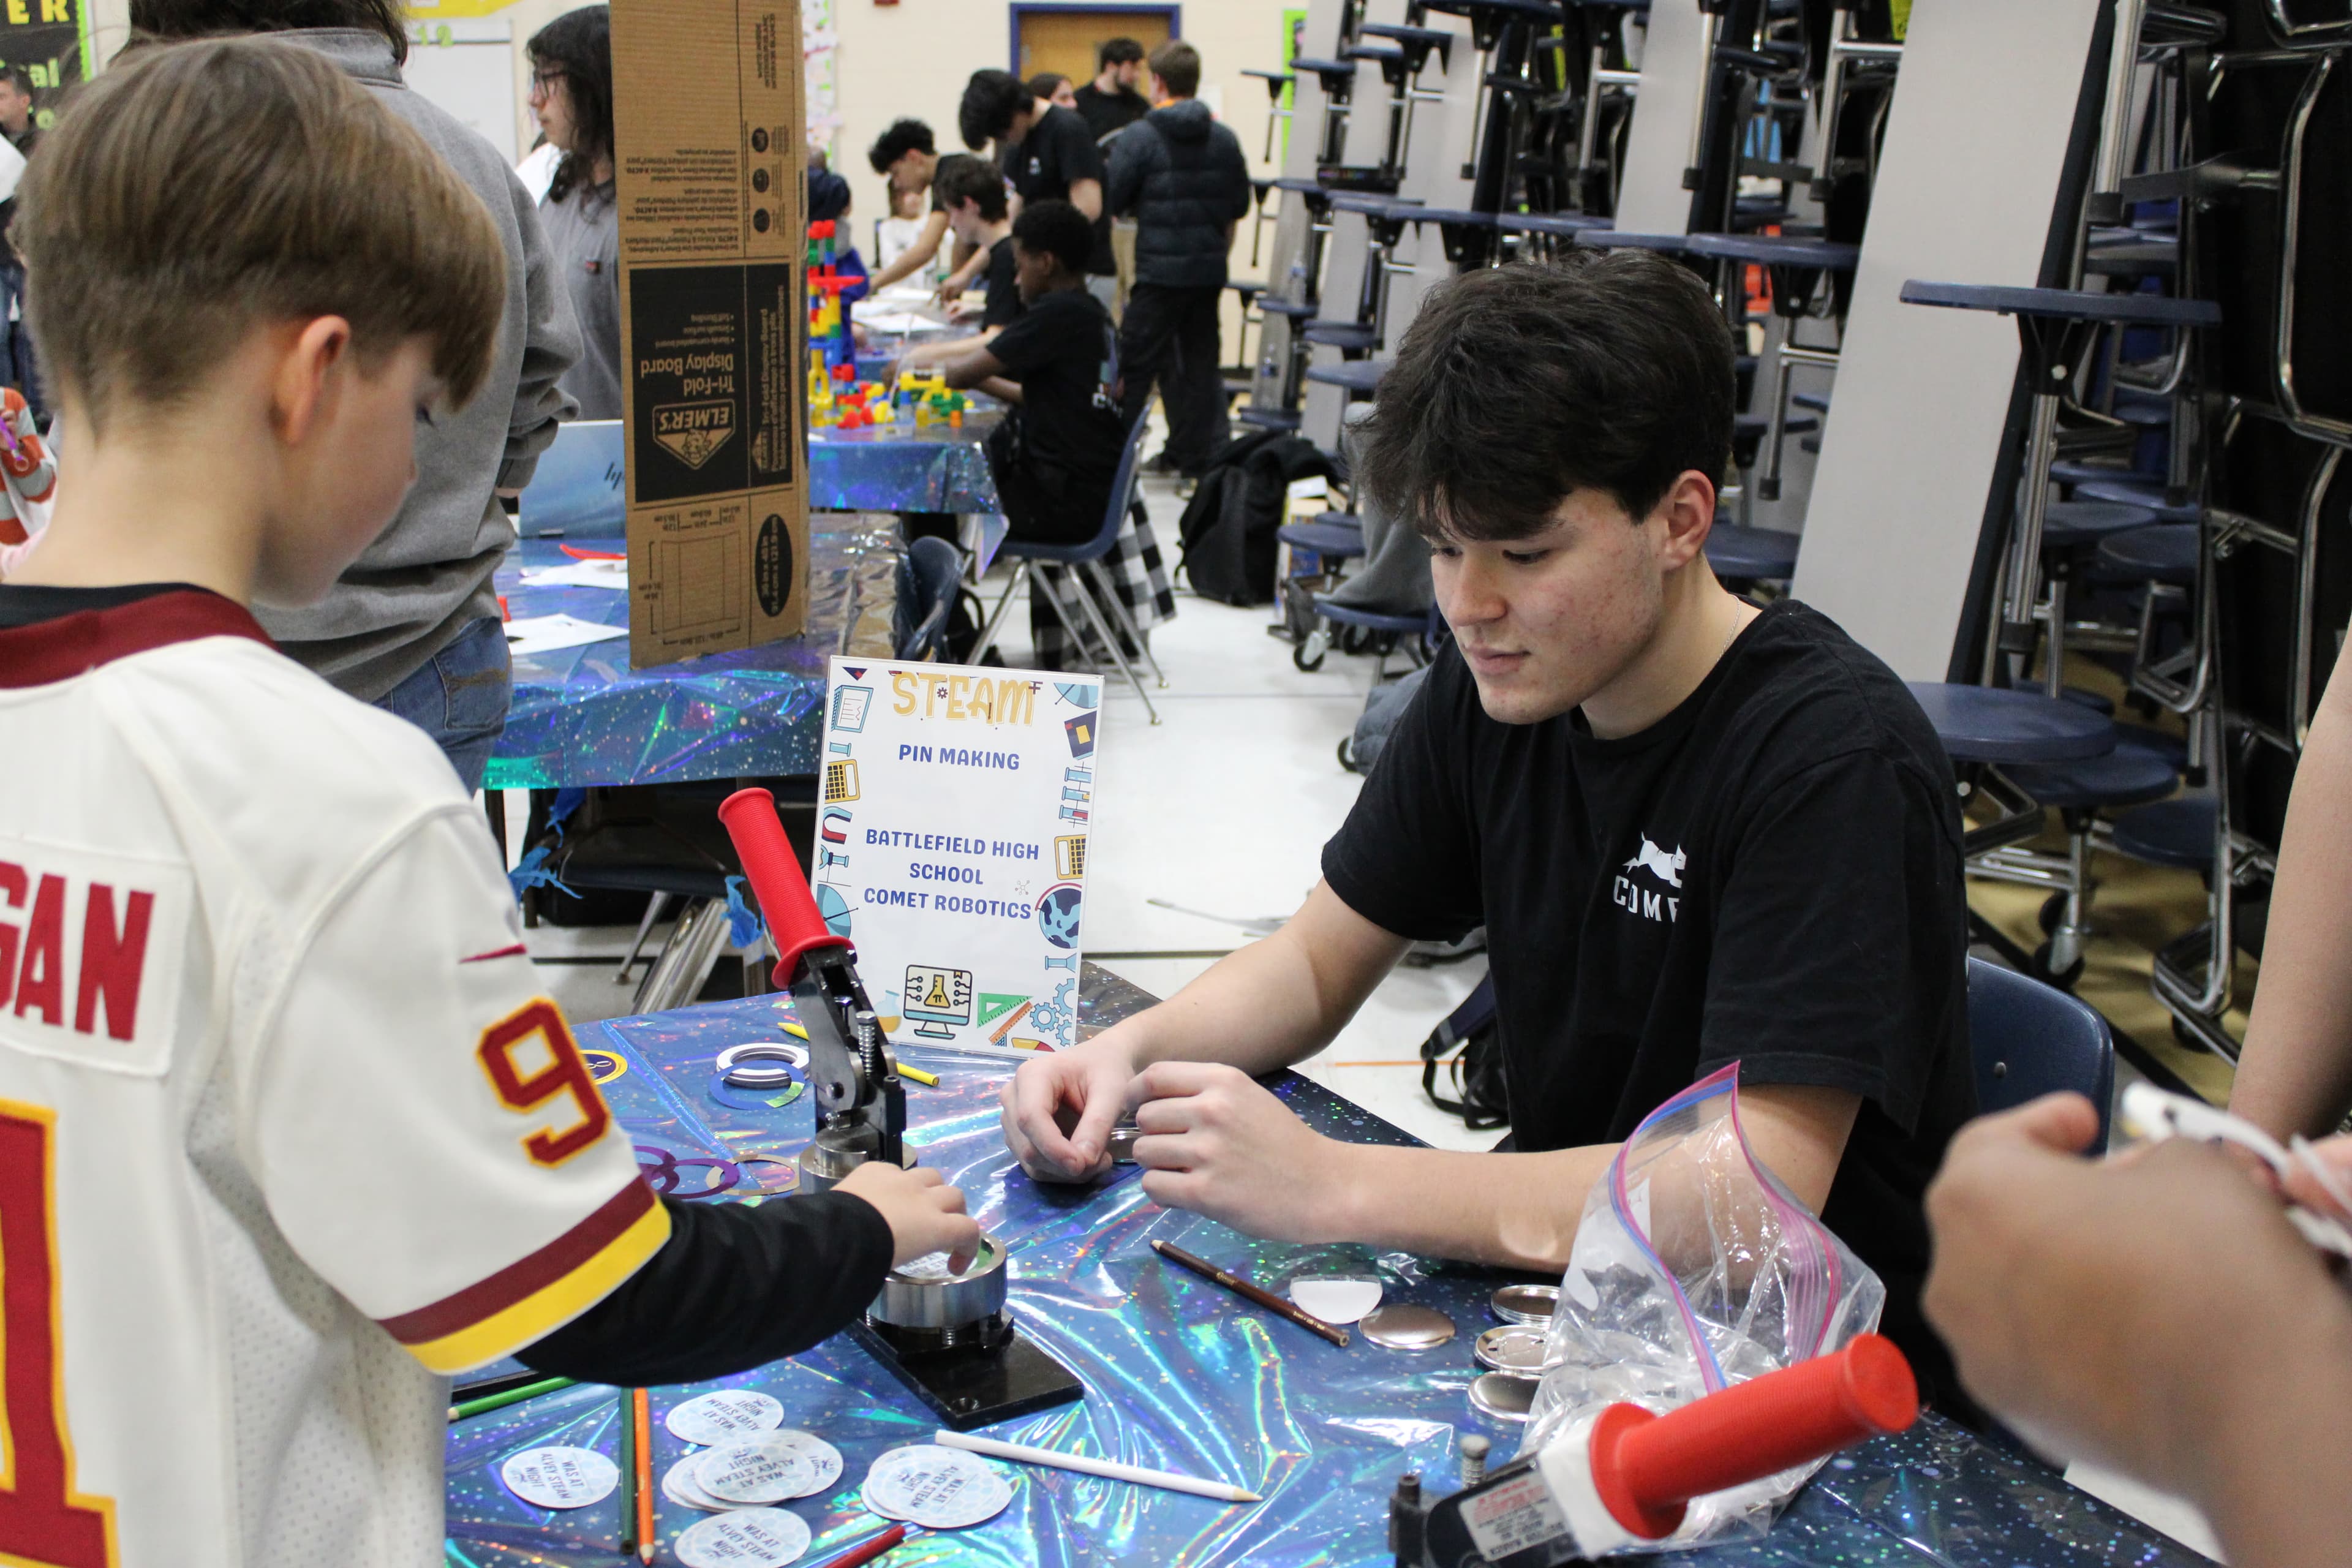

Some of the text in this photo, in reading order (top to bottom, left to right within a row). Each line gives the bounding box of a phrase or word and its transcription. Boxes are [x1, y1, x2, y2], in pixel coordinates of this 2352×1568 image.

[640, 353, 734, 378] Display Board
[684, 374, 735, 397] Tri-Fold
[659, 406, 730, 431] ELMER'S
[892, 671, 1035, 726] STEAM
[899, 744, 1020, 770] PIN MAKING
[865, 829, 1039, 860] BATTLEFIELD HIGH
[910, 862, 983, 885] SCHOOL
[864, 888, 1031, 919] COMET ROBOTICS
[706, 1398, 761, 1431] ALVEY STEAM
[734, 1400, 765, 1417] NIGHT
[715, 1416, 736, 1431] WAS
[562, 1460, 585, 1487] WAS AT
[728, 1454, 766, 1469] NIGHT
[758, 1458, 795, 1472] ALVEY
[526, 1467, 545, 1488] NIGHT
[541, 1453, 571, 1499] ALVEY STEAM
[714, 1468, 756, 1486] STEAM
[739, 1471, 787, 1488] WAS AT
[902, 1471, 931, 1493] NIGHT
[910, 1465, 959, 1508] ALVEY STEAM
[932, 1479, 966, 1504] WAS AT
[717, 1523, 778, 1561] ALVEY STEAM
[743, 1523, 781, 1548] WAS AT
[712, 1539, 745, 1559] NIGHT
